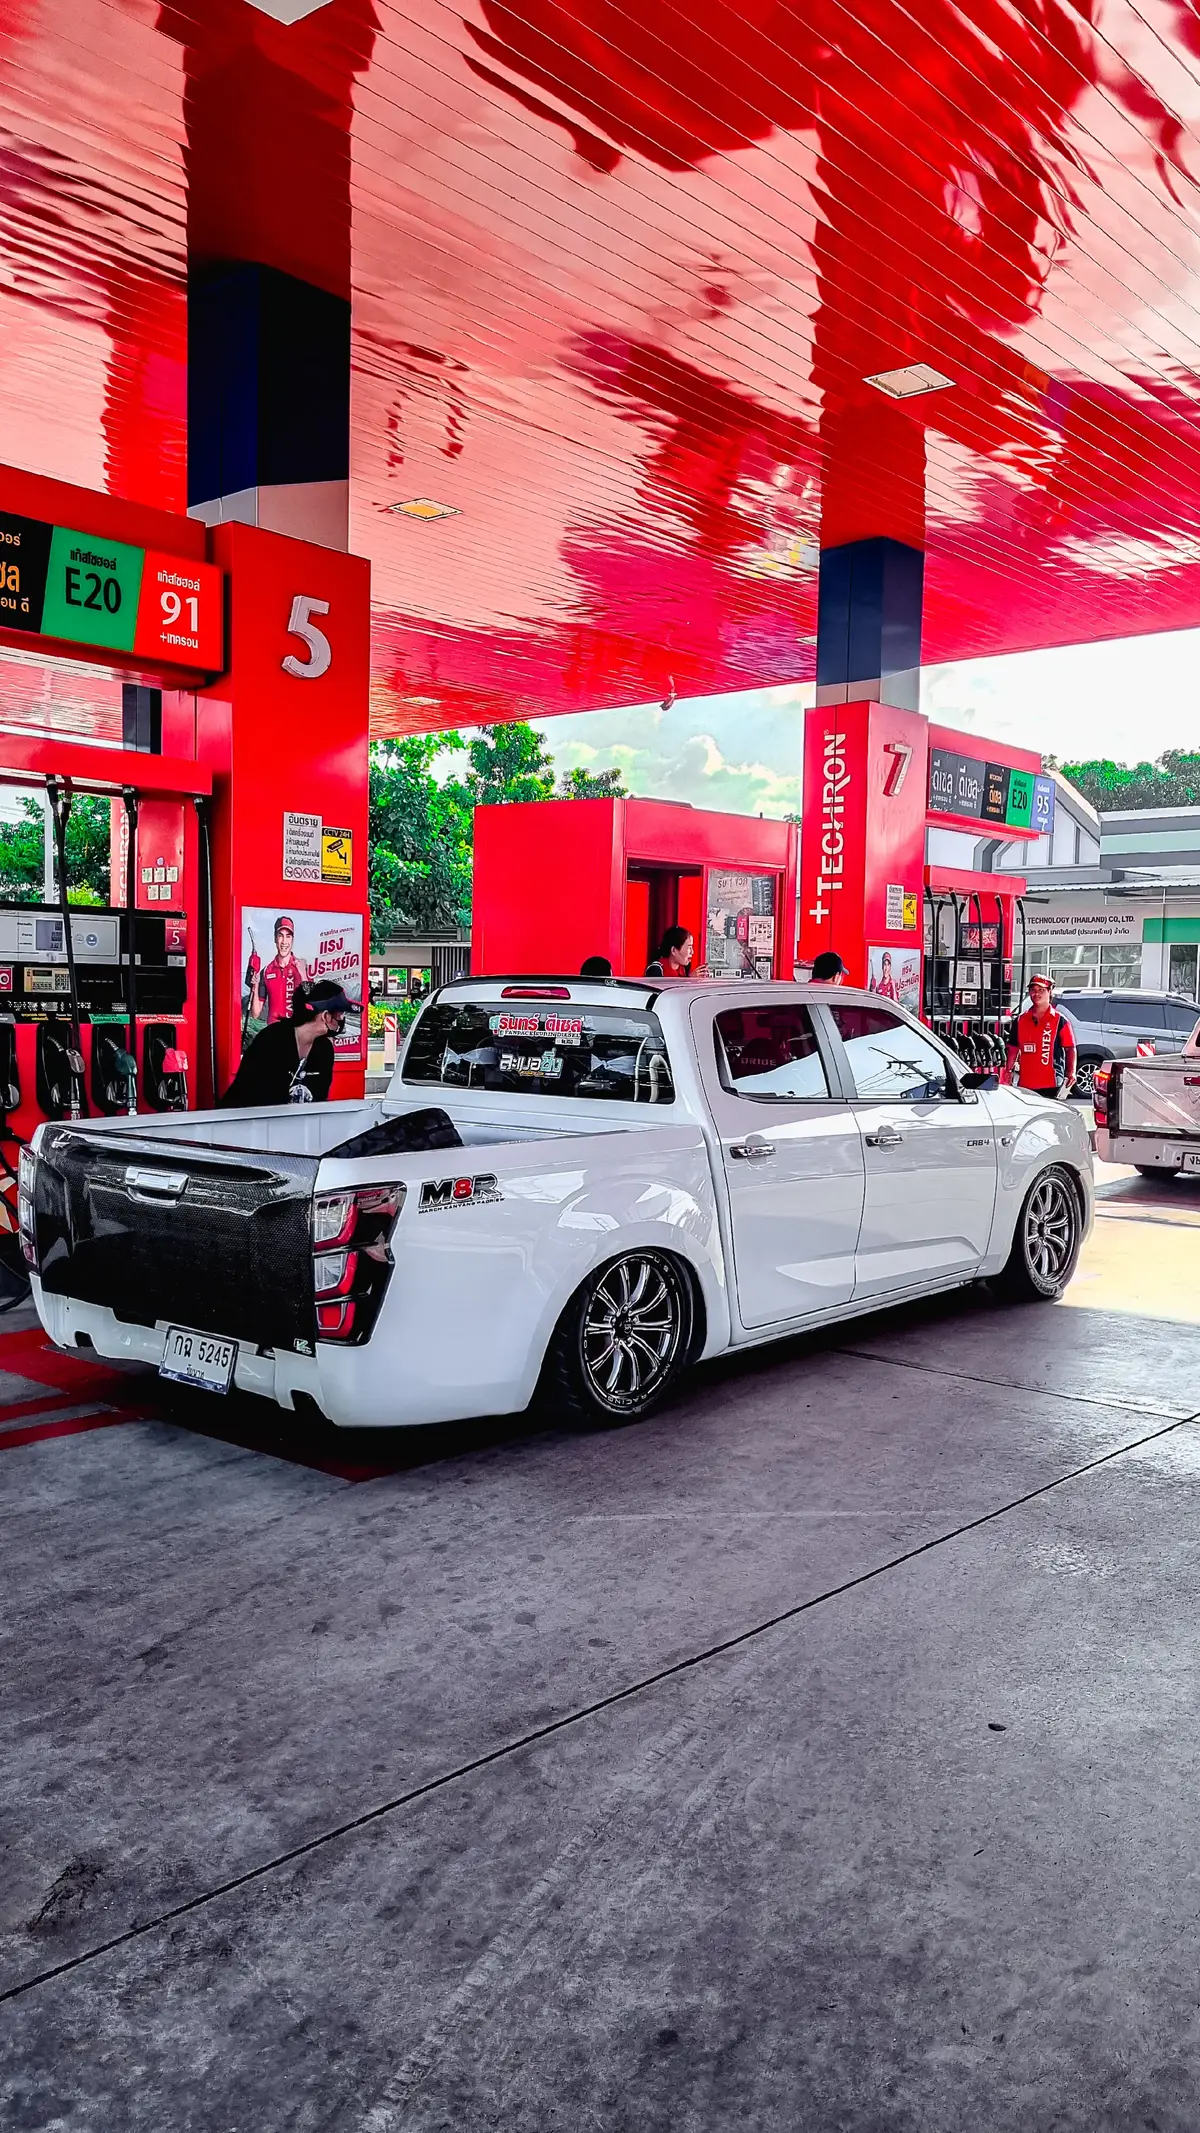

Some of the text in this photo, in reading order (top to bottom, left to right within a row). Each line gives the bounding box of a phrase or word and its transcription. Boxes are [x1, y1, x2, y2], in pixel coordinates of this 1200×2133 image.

[65, 566, 122, 614] E20
[157, 570, 200, 592] แก๊สโซฮอล์
[160, 591, 198, 632] 91
[160, 632, 199, 649] +เทครอน
[281, 595, 332, 678] 5
[883, 743, 913, 797] 7
[1012, 788, 1028, 811] E20
[1036, 794, 1050, 815] 95
[288, 814, 319, 828] อันตราย
[323, 829, 338, 837] CCTV
[1028, 916, 1069, 924] TECHNOLOGY
[1071, 915, 1107, 925] (THAILAND)
[171, 930, 180, 945] 5
[319, 937, 344, 955] แรง
[308, 951, 360, 978] ประหยัด
[544, 1013, 583, 1033] ดีเซล
[1042, 1029, 1052, 1066] CALTEX
[418, 1173, 503, 1209] M8R
[418, 1206, 443, 1214] MARCH
[198, 1341, 231, 1368] 5245
